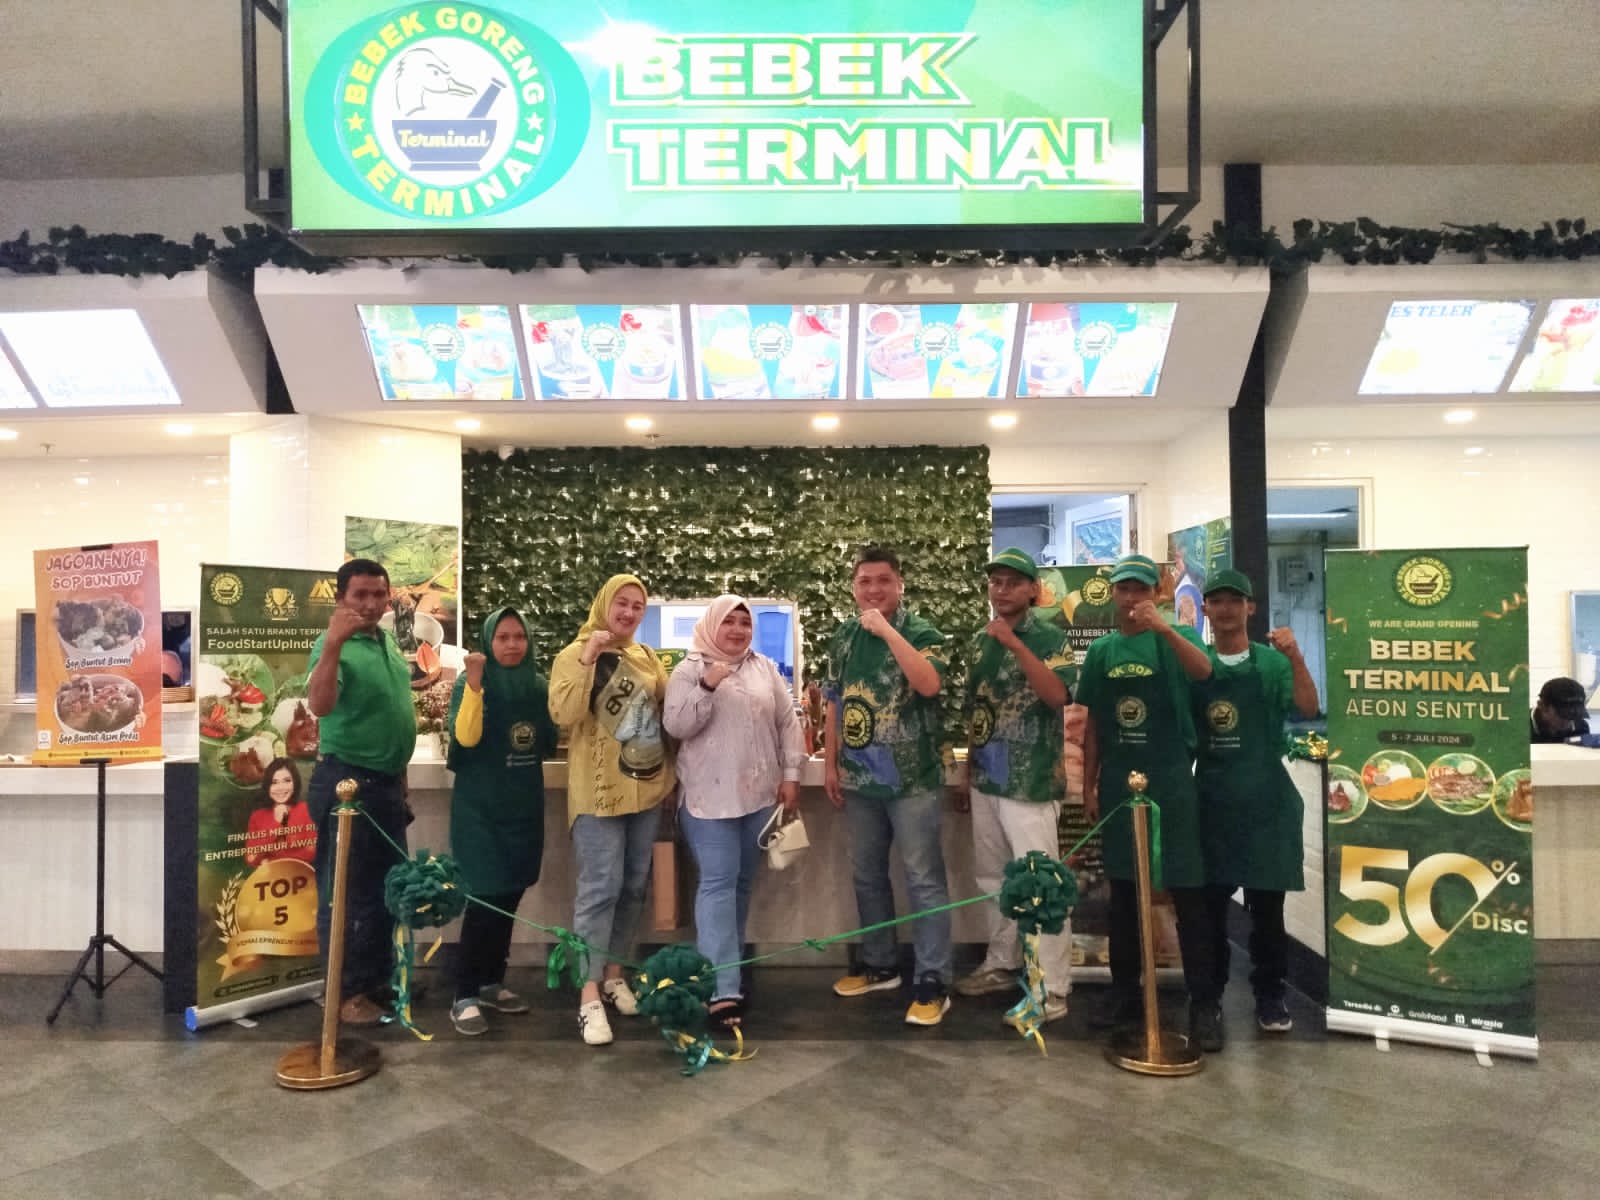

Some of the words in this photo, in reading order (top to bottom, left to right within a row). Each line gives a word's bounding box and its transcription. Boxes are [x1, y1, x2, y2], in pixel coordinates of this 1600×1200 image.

[344, 11, 425, 105] BEBEK
[436, 8, 545, 105] GORENG
[616, 36, 966, 103] BEBEK
[398, 129, 490, 148] Terminal
[610, 121, 1136, 188] TERMINAL
[351, 134, 545, 217] TERMINAL
[52, 576, 82, 590] SOP
[84, 571, 143, 588] BUNTUT
[206, 627, 239, 635] SALAH
[242, 627, 265, 635] SATU
[267, 627, 297, 635] BRAND
[1063, 628, 1081, 636] ATU
[1369, 620, 1382, 628] WE
[1384, 620, 1402, 628] ARE
[1403, 620, 1435, 628] GRAND
[1437, 620, 1480, 628] OPENING
[1370, 640, 1476, 661] BEBEK
[1344, 669, 1510, 693] TERMINAL
[1346, 699, 1407, 717] AEON
[1416, 701, 1510, 721] SENTUL
[1391, 733, 1398, 741] 5
[1413, 735, 1435, 743] JULI
[227, 830, 267, 843] FINALIS
[269, 825, 303, 836] MERRY
[205, 842, 288, 861] ENTREPRENEUR
[254, 876, 308, 901] TOP
[274, 905, 289, 926] 5
[1472, 912, 1529, 934] Disc
